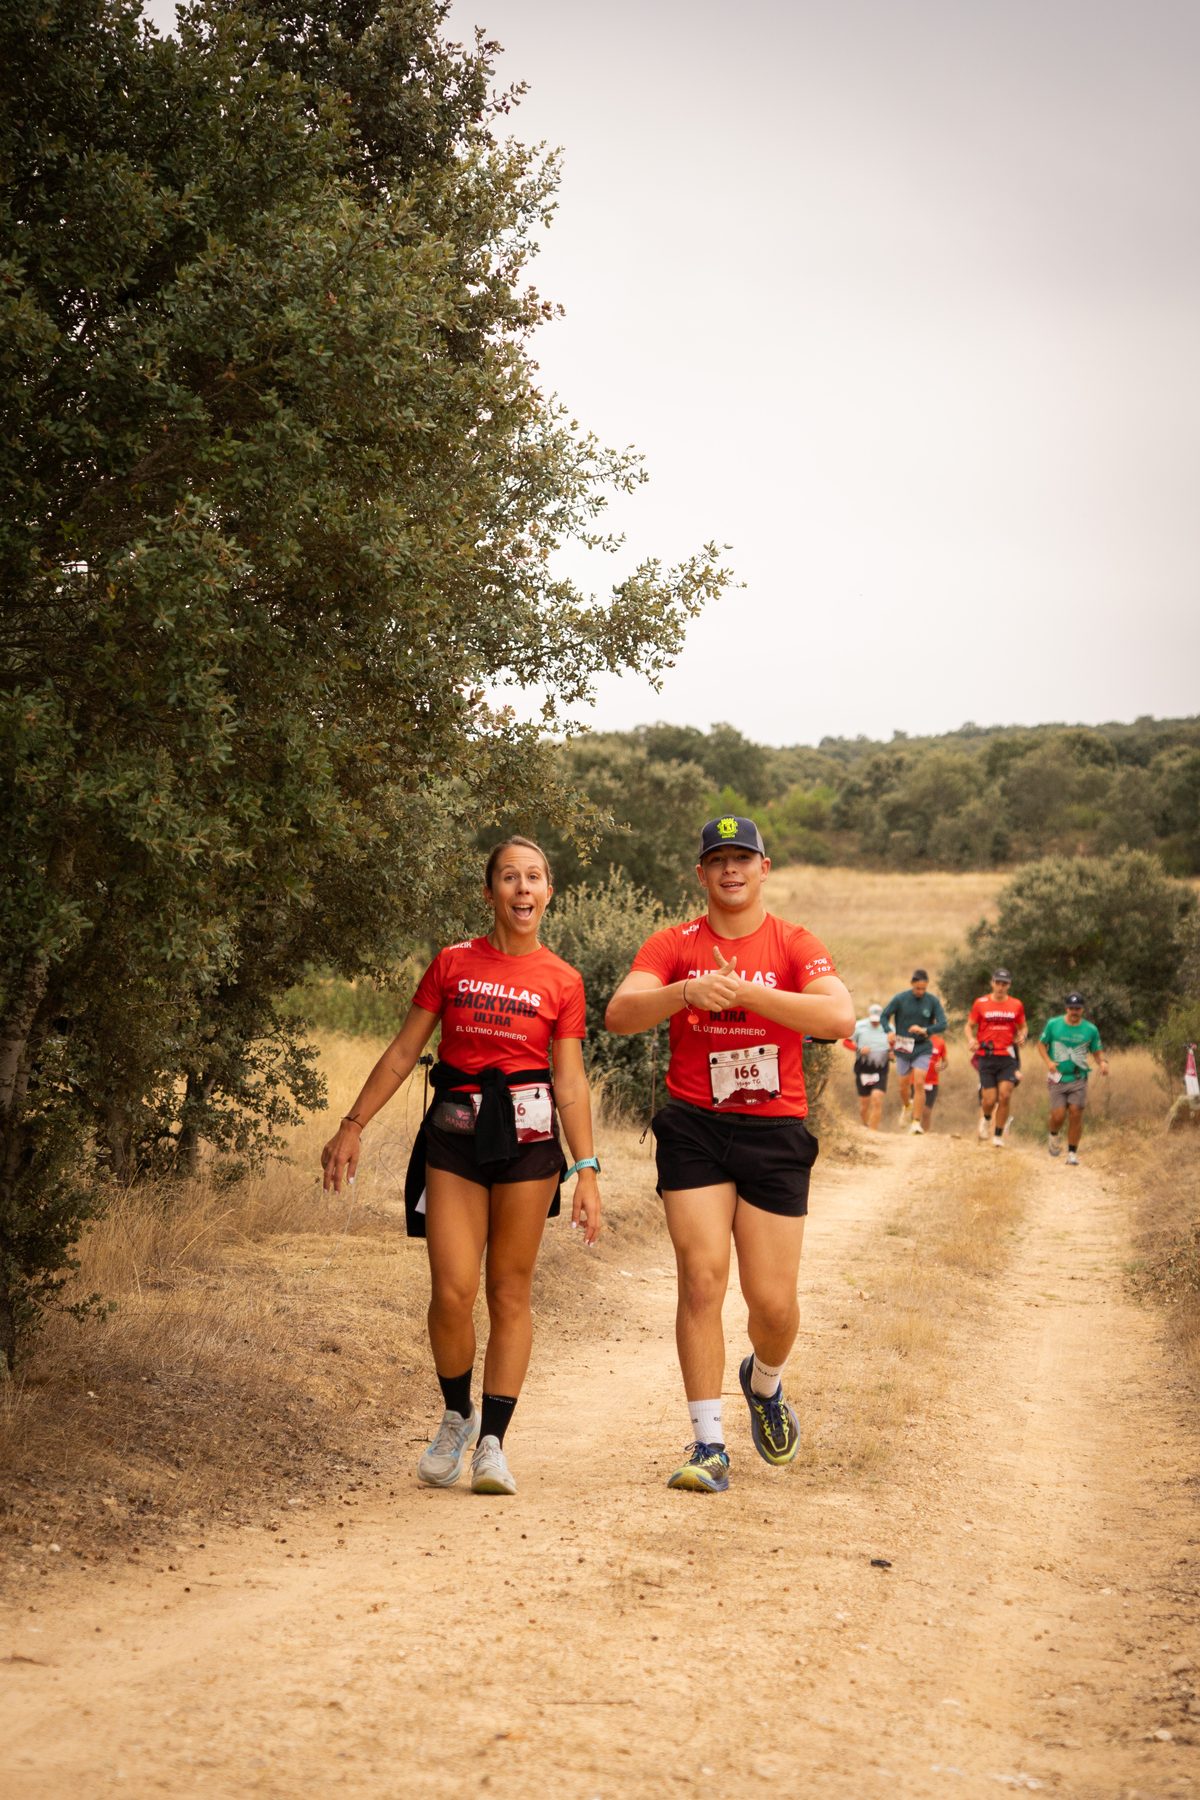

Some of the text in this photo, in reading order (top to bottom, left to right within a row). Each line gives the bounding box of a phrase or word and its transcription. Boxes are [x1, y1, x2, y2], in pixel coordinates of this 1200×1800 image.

[458, 979, 541, 1007] CURILLAS
[453, 992, 538, 1018] BACKYARD
[474, 1012, 511, 1027] ULTRA
[493, 1029, 528, 1042] ARRIERO
[693, 1024, 702, 1032] EL
[728, 1027, 767, 1037] ARRIERO
[735, 1064, 760, 1079] 166
